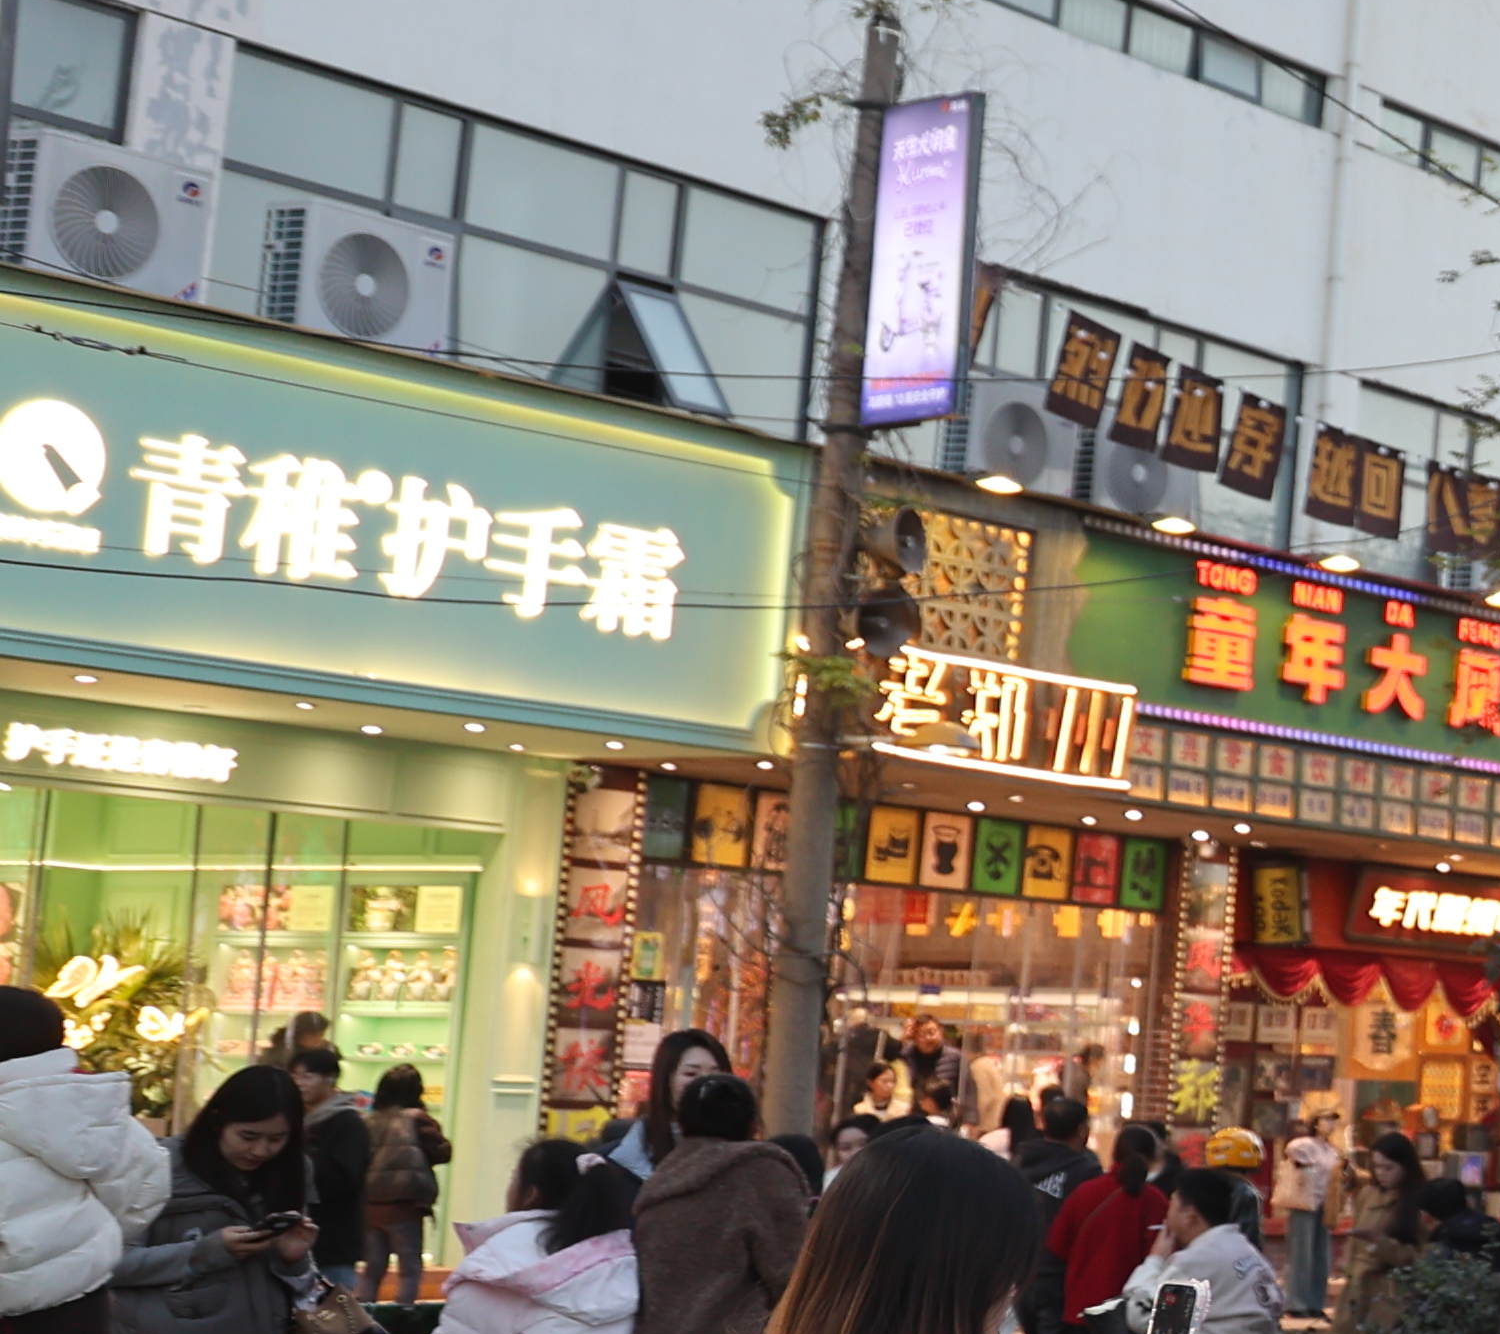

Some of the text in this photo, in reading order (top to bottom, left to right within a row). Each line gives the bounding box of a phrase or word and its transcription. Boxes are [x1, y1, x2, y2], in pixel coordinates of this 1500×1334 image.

[1197, 560, 1258, 595] TONG
[1292, 580, 1344, 614] NIAN
[1384, 599, 1415, 629] DA
